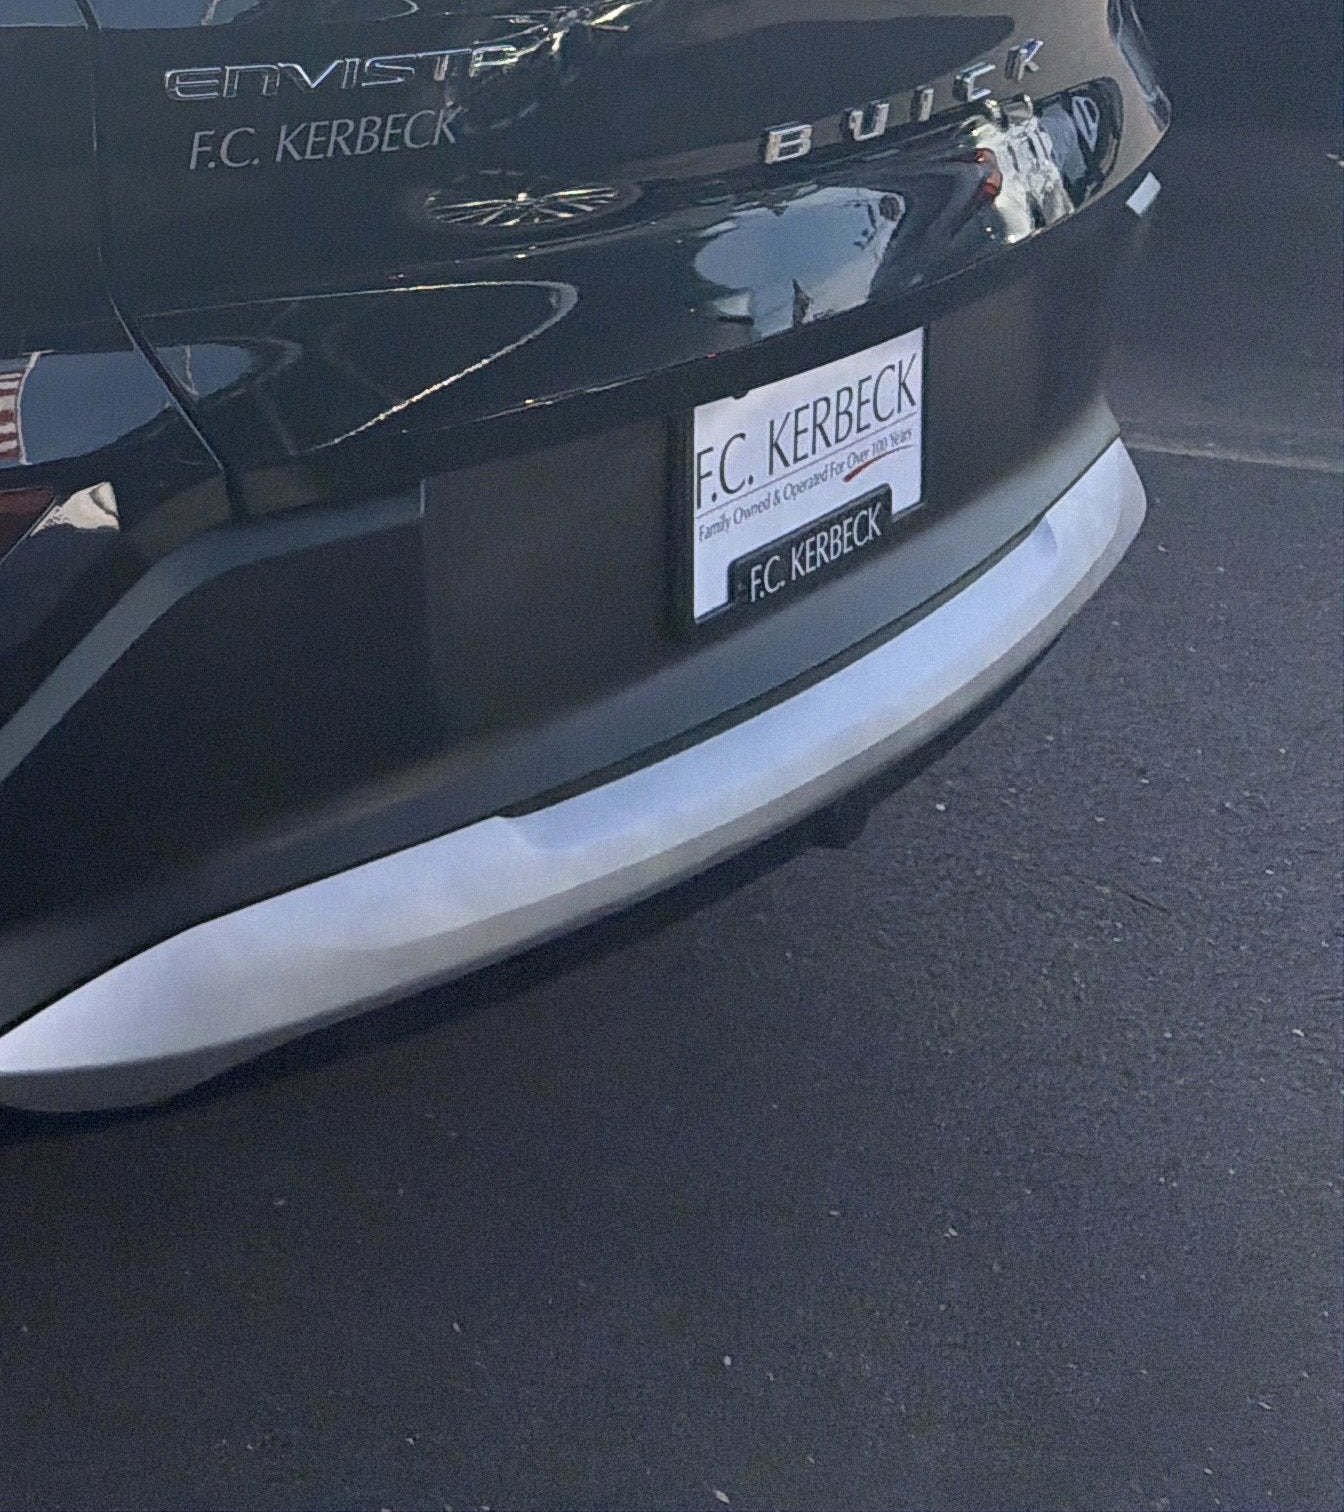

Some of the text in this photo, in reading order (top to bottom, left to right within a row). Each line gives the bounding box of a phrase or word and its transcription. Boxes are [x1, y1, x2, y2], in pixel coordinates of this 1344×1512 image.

[188, 105, 462, 170] F.C. KERBECK
[762, 39, 1043, 165] BUICK
[695, 353, 918, 509] F.C. KERBECK
[698, 513, 731, 542] Family
[733, 492, 772, 525] Owned
[773, 489, 782, 507] &
[783, 463, 828, 501] Operated
[830, 460, 846, 477] For
[847, 449, 870, 469] Over
[890, 428, 913, 448] Years
[749, 502, 883, 603] F.C. KERBECK
